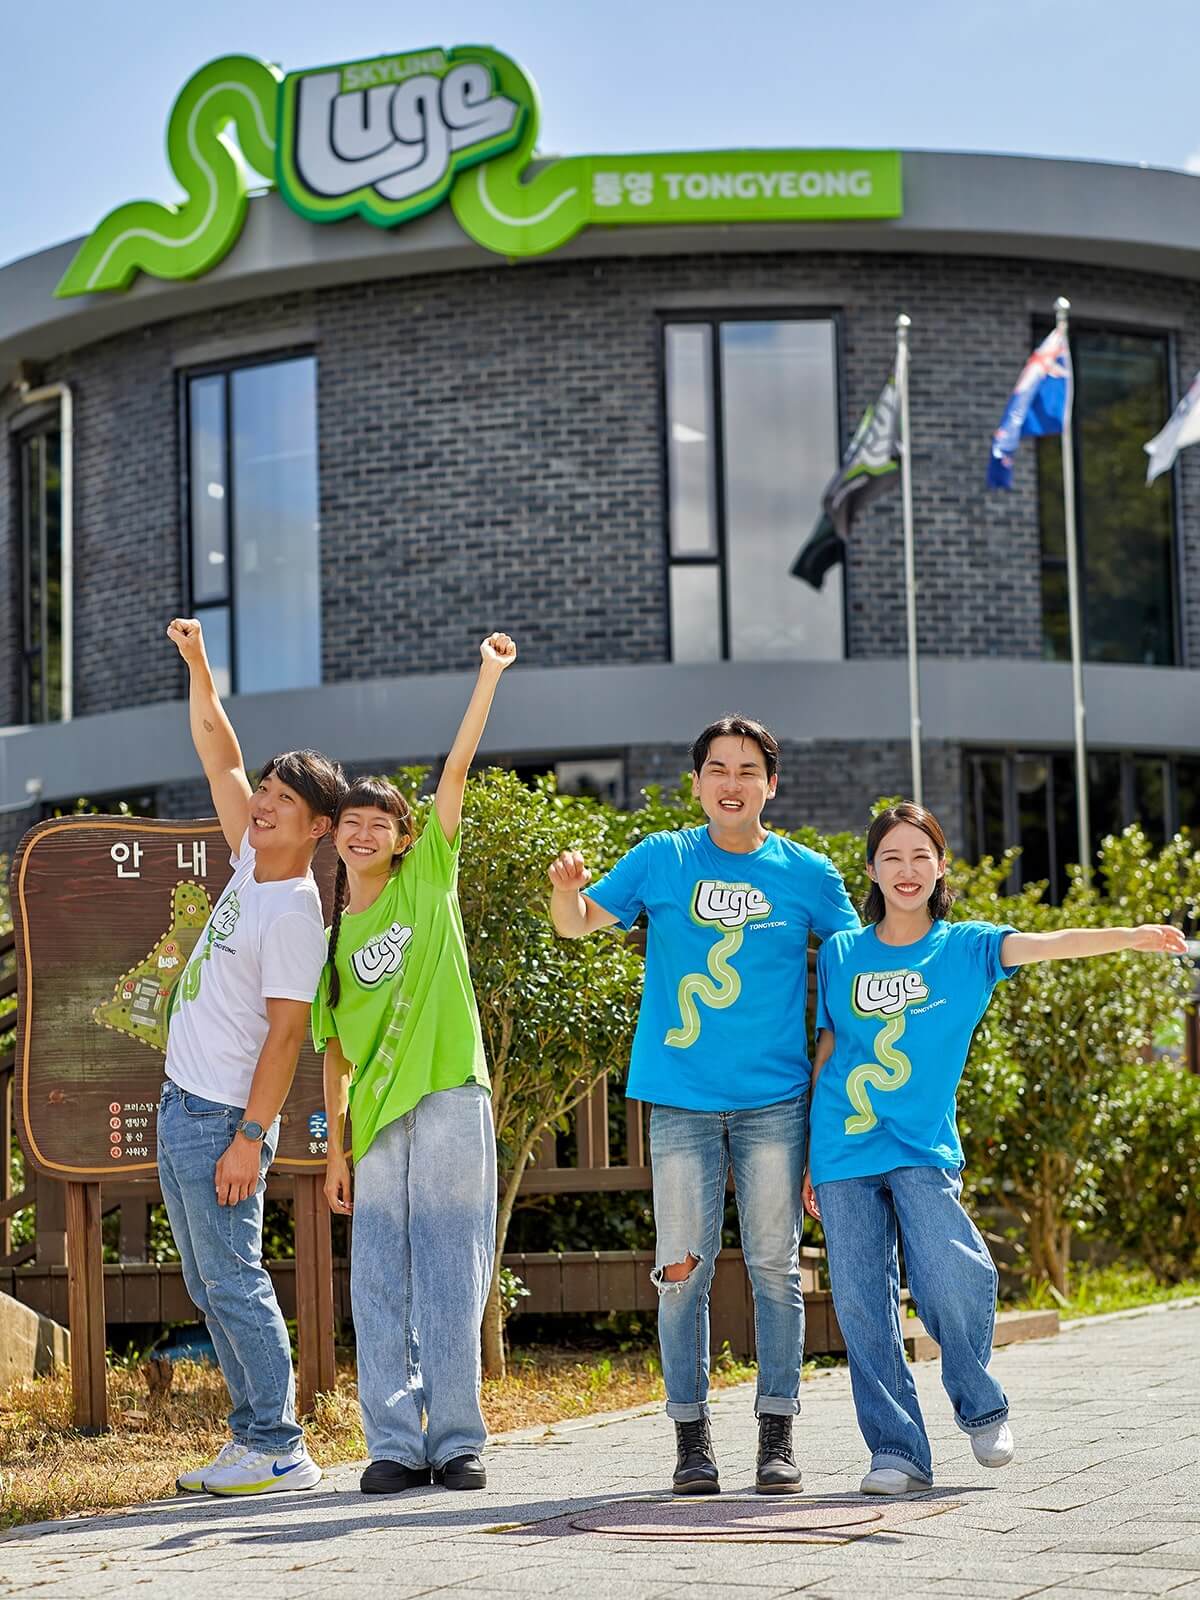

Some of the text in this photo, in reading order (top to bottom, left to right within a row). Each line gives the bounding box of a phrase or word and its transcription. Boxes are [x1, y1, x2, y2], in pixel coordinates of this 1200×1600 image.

[295, 62, 518, 200] Luge
[593, 170, 872, 206] 통영 TONGYEONG
[695, 881, 772, 927] Luge
[749, 920, 788, 931] TONGYEONG
[352, 922, 413, 984] Luge
[855, 973, 929, 1015] Luge
